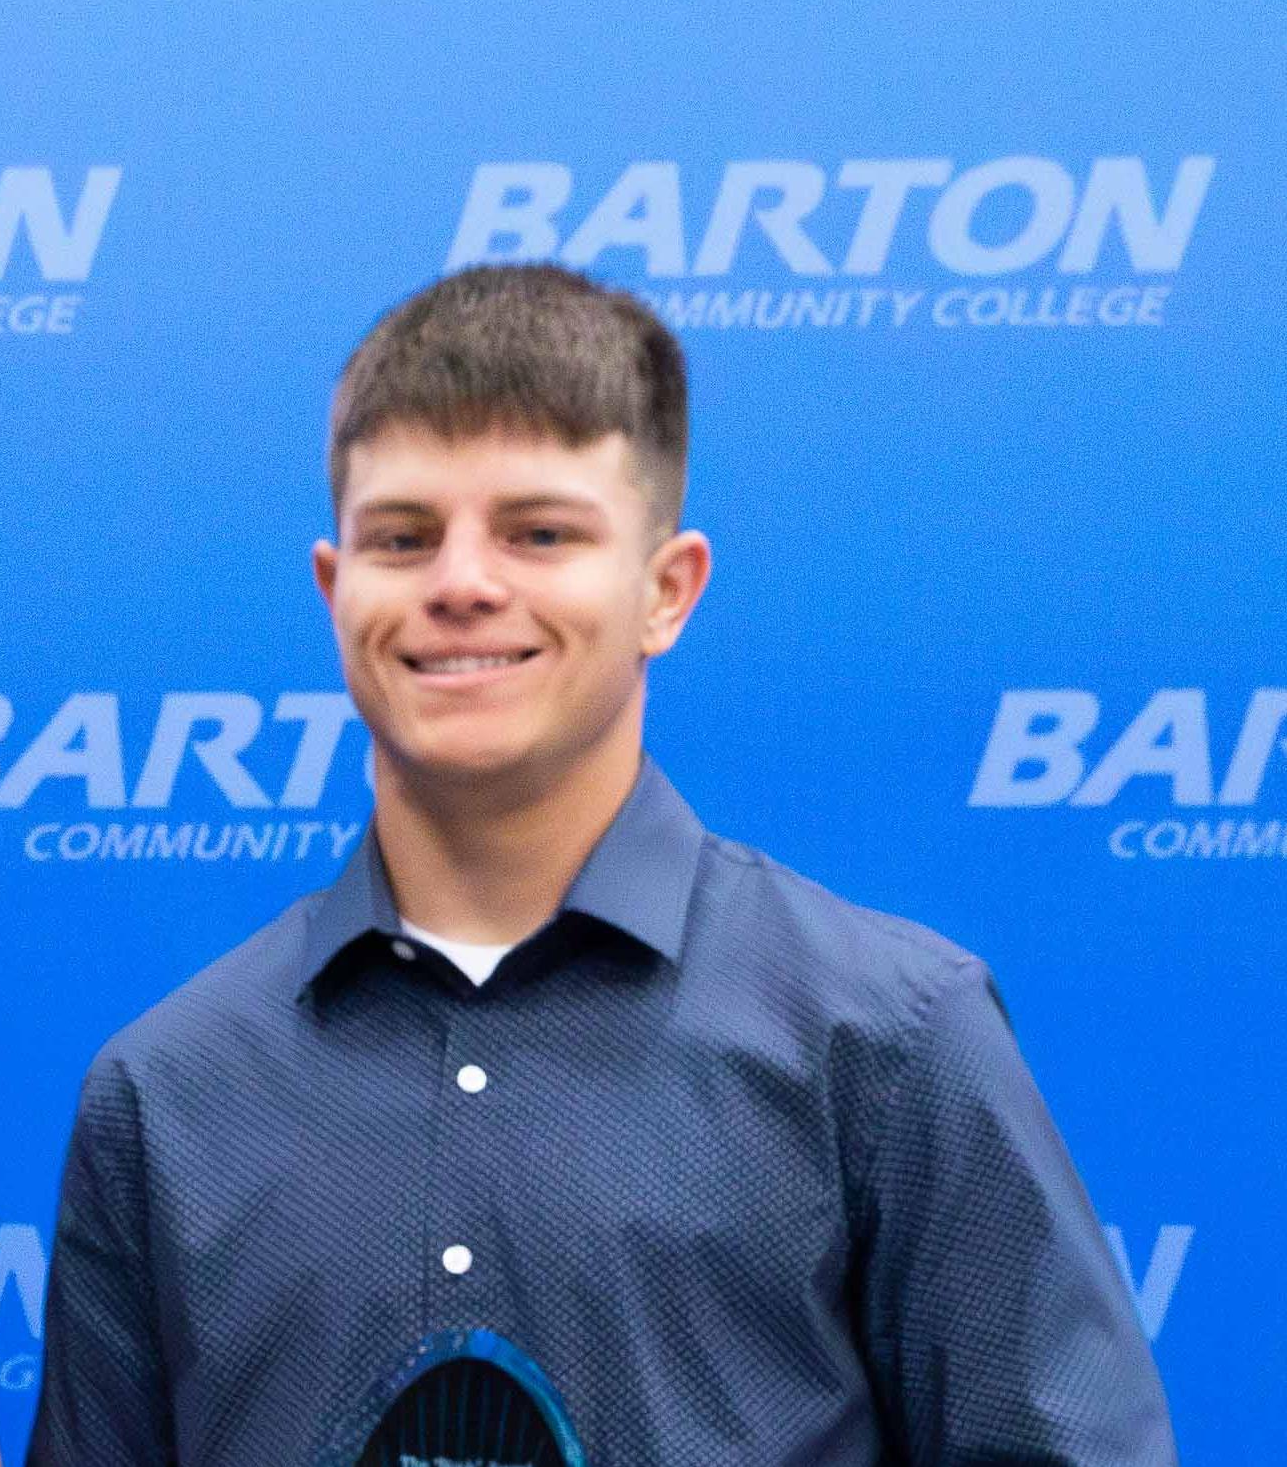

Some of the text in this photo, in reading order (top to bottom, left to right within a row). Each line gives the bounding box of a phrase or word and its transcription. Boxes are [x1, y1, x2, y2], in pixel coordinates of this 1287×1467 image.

[441, 156, 1216, 277] BARTON
[932, 285, 1171, 327] COLLEGE
[25, 820, 360, 863] COMMUNITY
